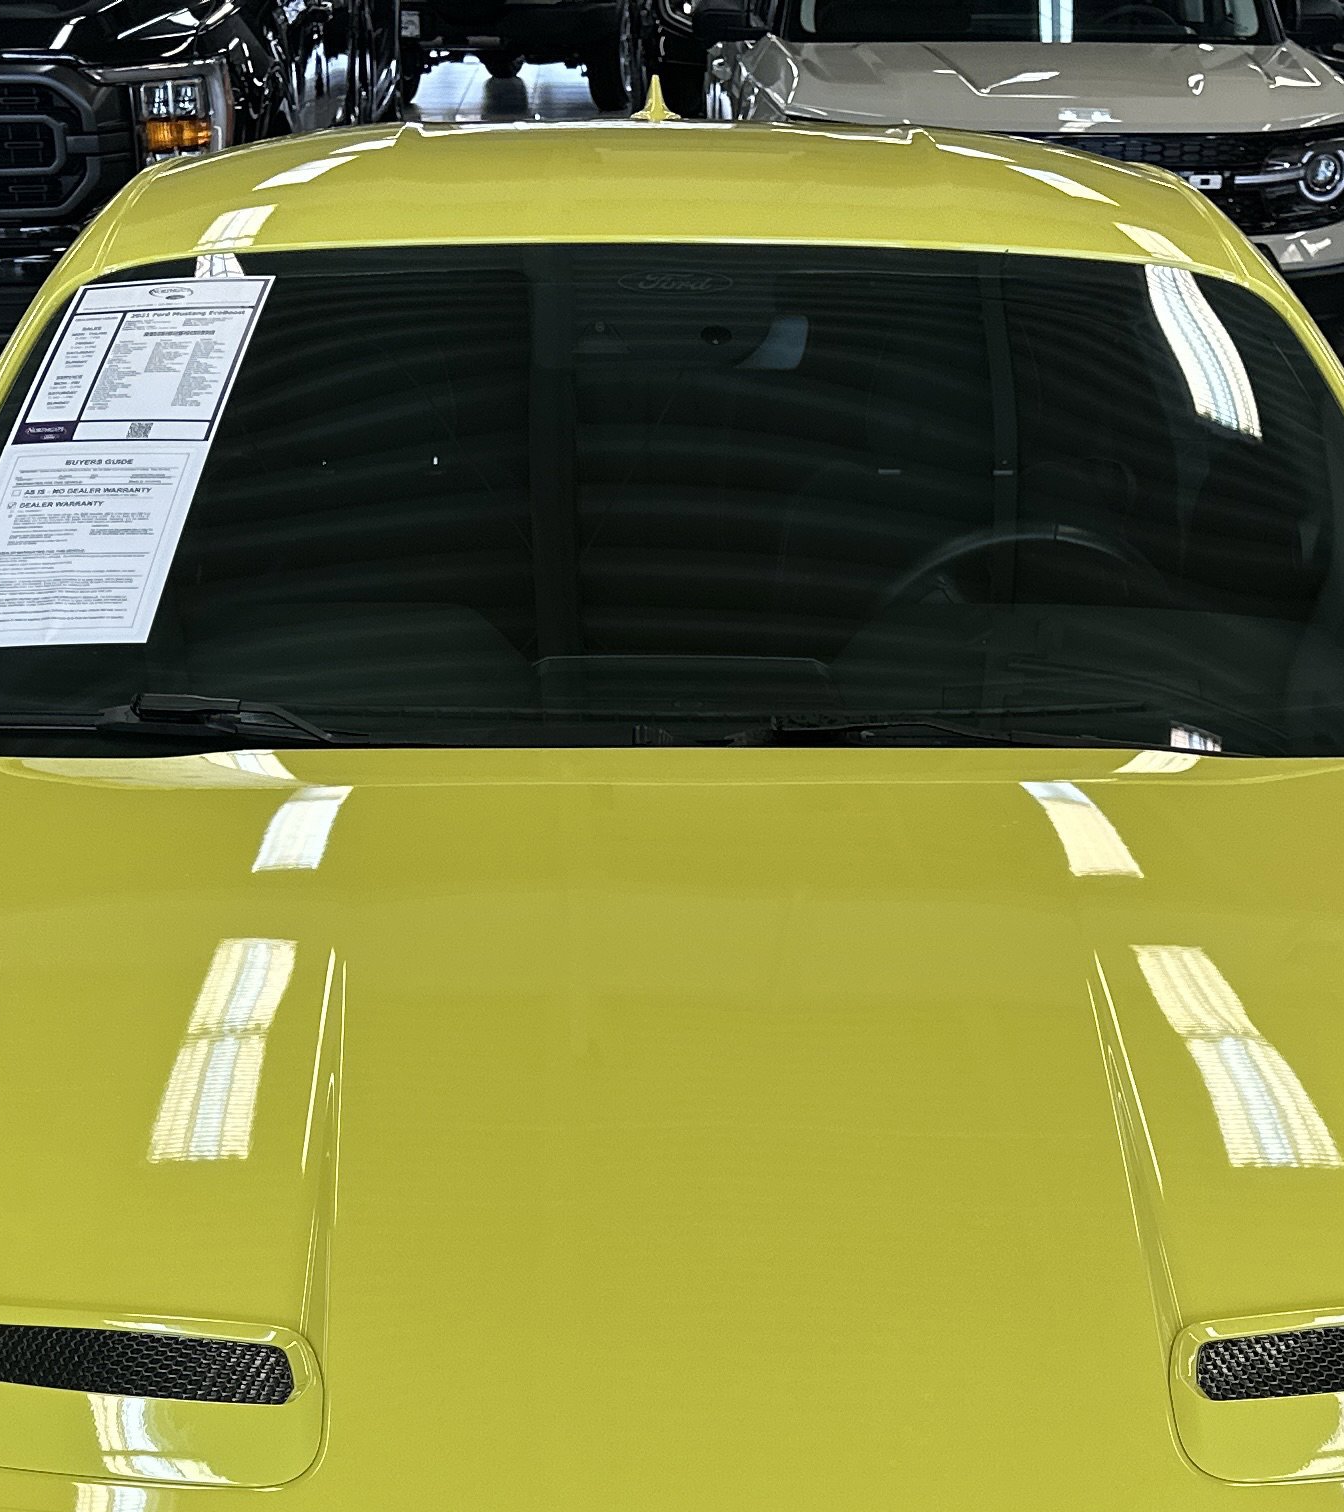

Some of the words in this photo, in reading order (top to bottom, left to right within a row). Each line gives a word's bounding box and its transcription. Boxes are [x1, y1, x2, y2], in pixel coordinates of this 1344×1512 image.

[637, 273, 713, 290] Ford
[67, 487, 101, 495] DEALER
[19, 501, 53, 509] DEALER
[55, 500, 105, 508] WARRANTY
